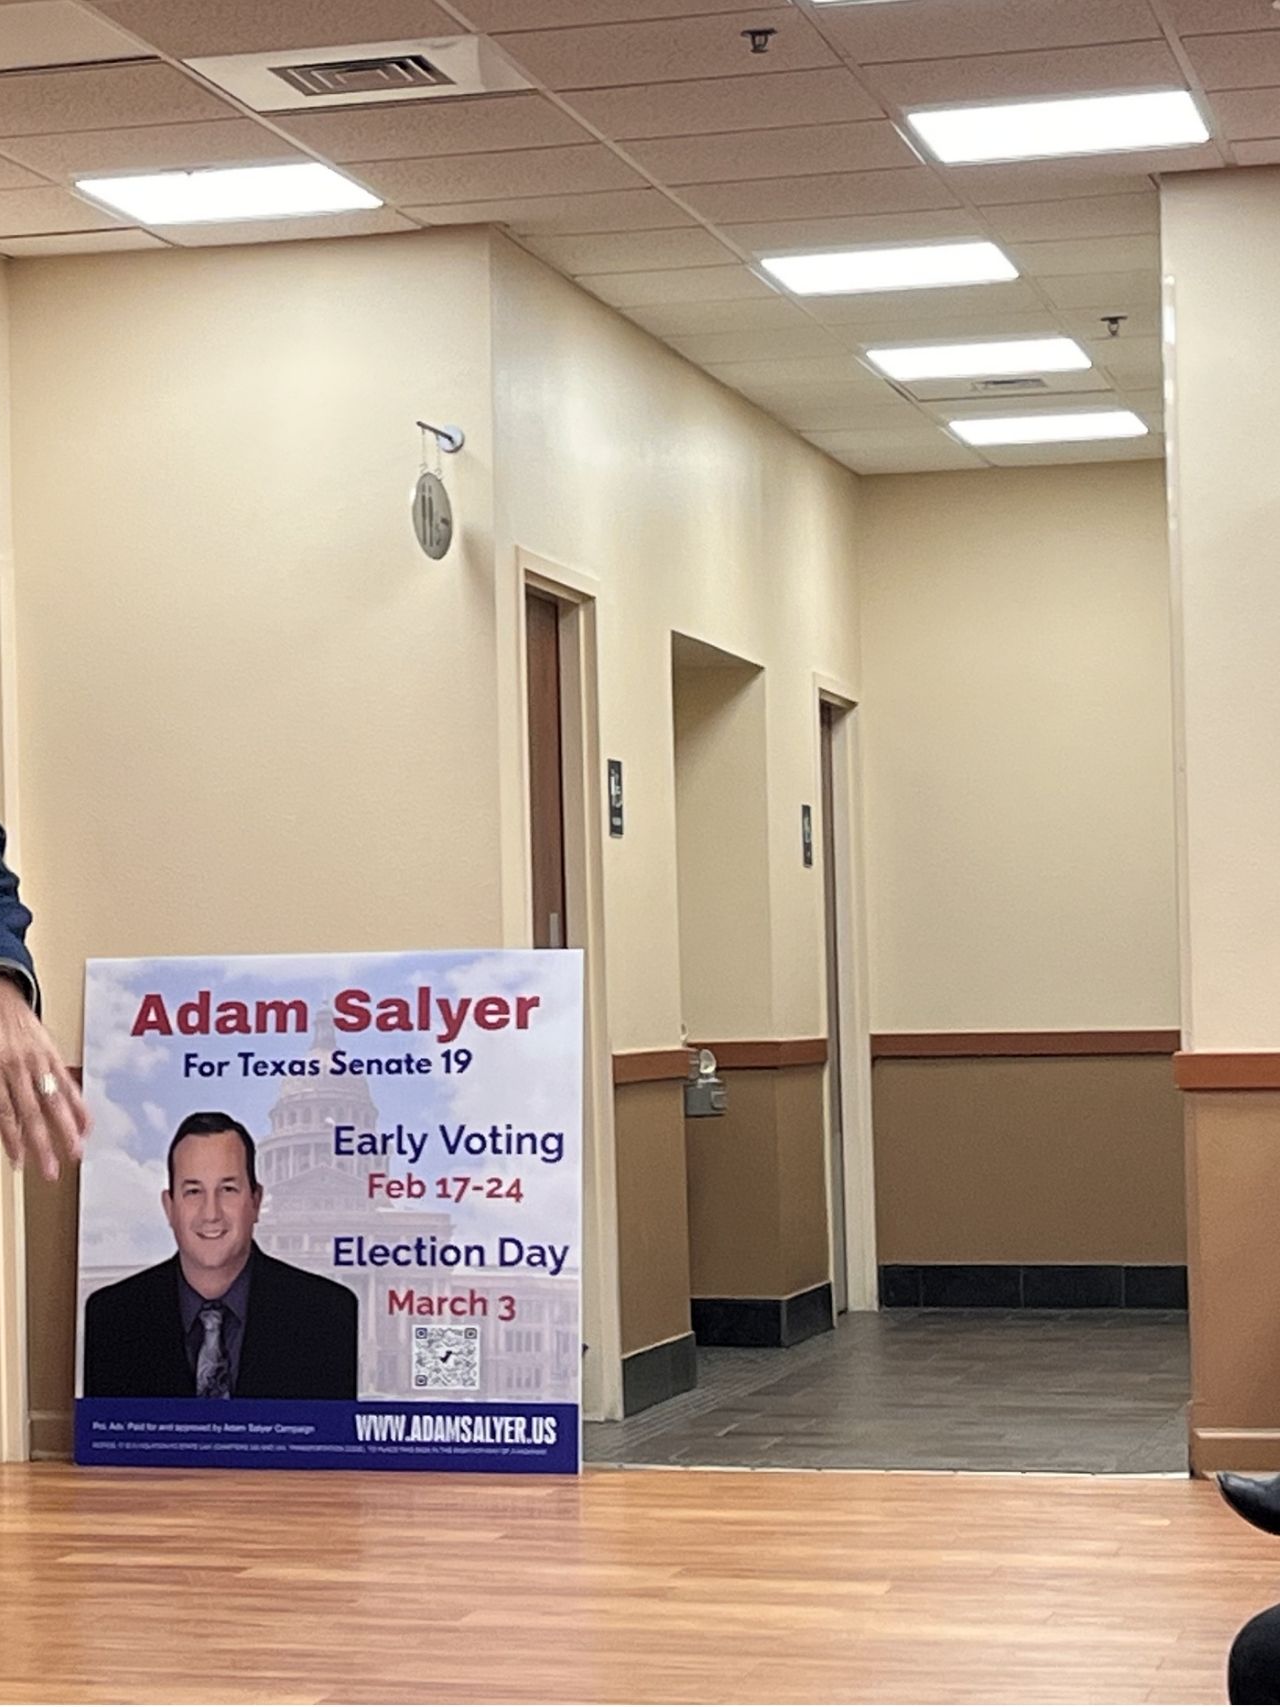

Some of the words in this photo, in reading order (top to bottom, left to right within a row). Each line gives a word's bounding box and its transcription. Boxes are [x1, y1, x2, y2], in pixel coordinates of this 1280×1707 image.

[131, 991, 308, 1036] Adam
[333, 986, 540, 1043] Salyer
[183, 1052, 230, 1078] For
[237, 1051, 321, 1077] Texas
[330, 1049, 432, 1077] Senate
[440, 1049, 473, 1075] 19
[334, 1125, 428, 1164] Early
[439, 1124, 565, 1164] Voting
[368, 1173, 426, 1200] Feb
[435, 1176, 524, 1204] 17-24
[333, 1236, 486, 1268] Election
[498, 1237, 570, 1276] Day
[388, 1289, 488, 1318] March
[497, 1295, 517, 1321] 3
[355, 1413, 557, 1445] WWW.ADAMSALYER.US
